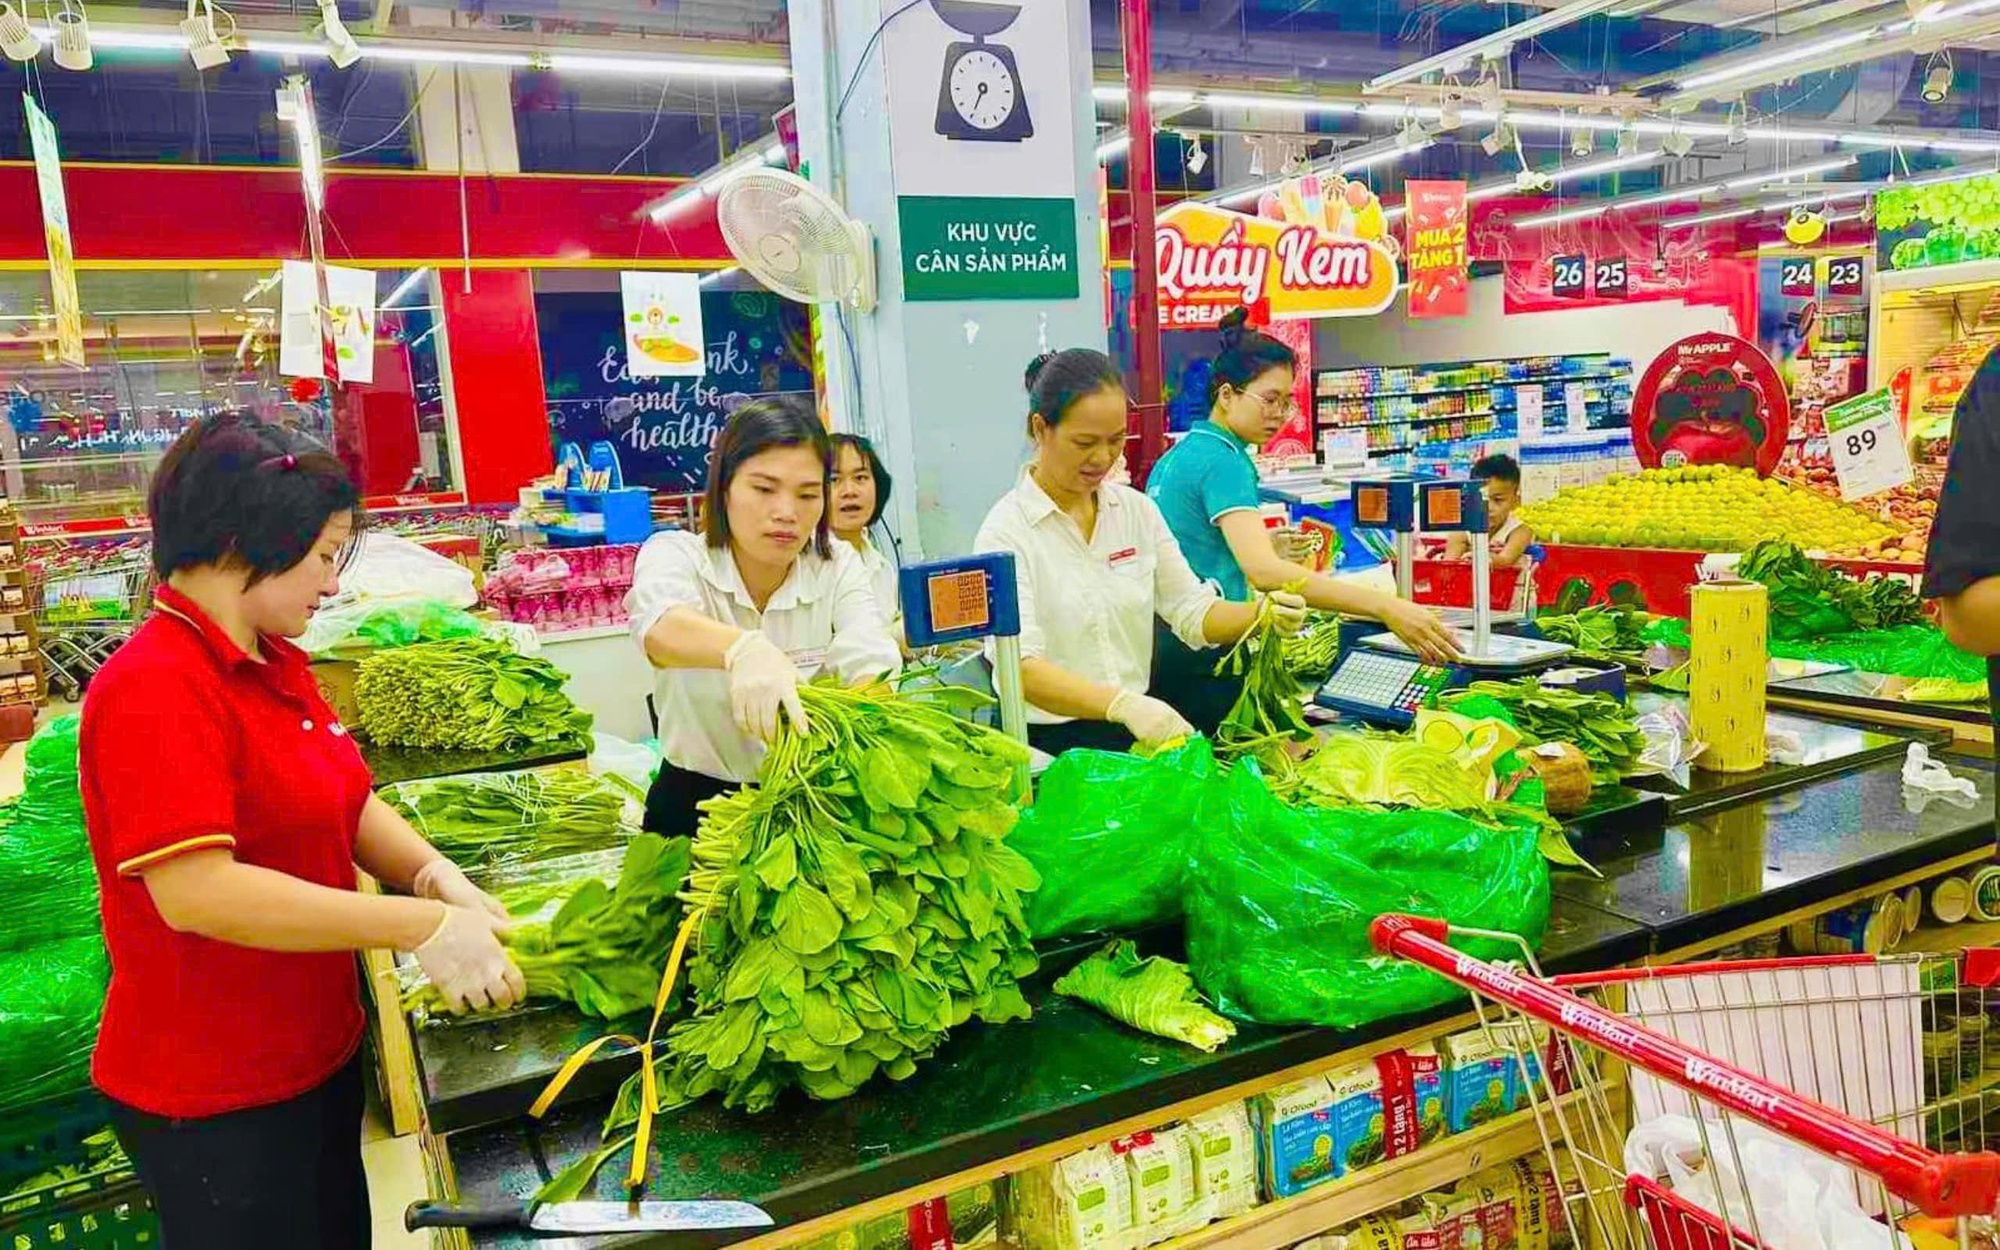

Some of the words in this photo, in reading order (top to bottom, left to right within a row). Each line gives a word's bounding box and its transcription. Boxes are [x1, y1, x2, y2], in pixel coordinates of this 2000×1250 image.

[947, 223, 989, 242] KHU
[994, 221, 1037, 246] VỰC
[1415, 229, 1451, 247] MUA
[1452, 222, 1466, 243] 2
[915, 249, 960, 273] CÂN
[965, 247, 1007, 272] SẢN
[1012, 245, 1067, 272] PHẨM
[1156, 218, 1268, 304] Quầy
[1279, 229, 1369, 286] Kem
[1454, 245, 1463, 266] 1
[1555, 262, 1583, 286] 26
[1597, 262, 1625, 288] 25
[1783, 263, 1812, 286] 24
[1830, 263, 1860, 285] 23
[630, 382, 688, 414] and
[686, 376, 722, 407] be
[620, 411, 725, 464] health
[1846, 429, 1876, 456] 89
[1561, 1001, 1640, 1047] WinMart
[1684, 1056, 1783, 1113] WinMart
